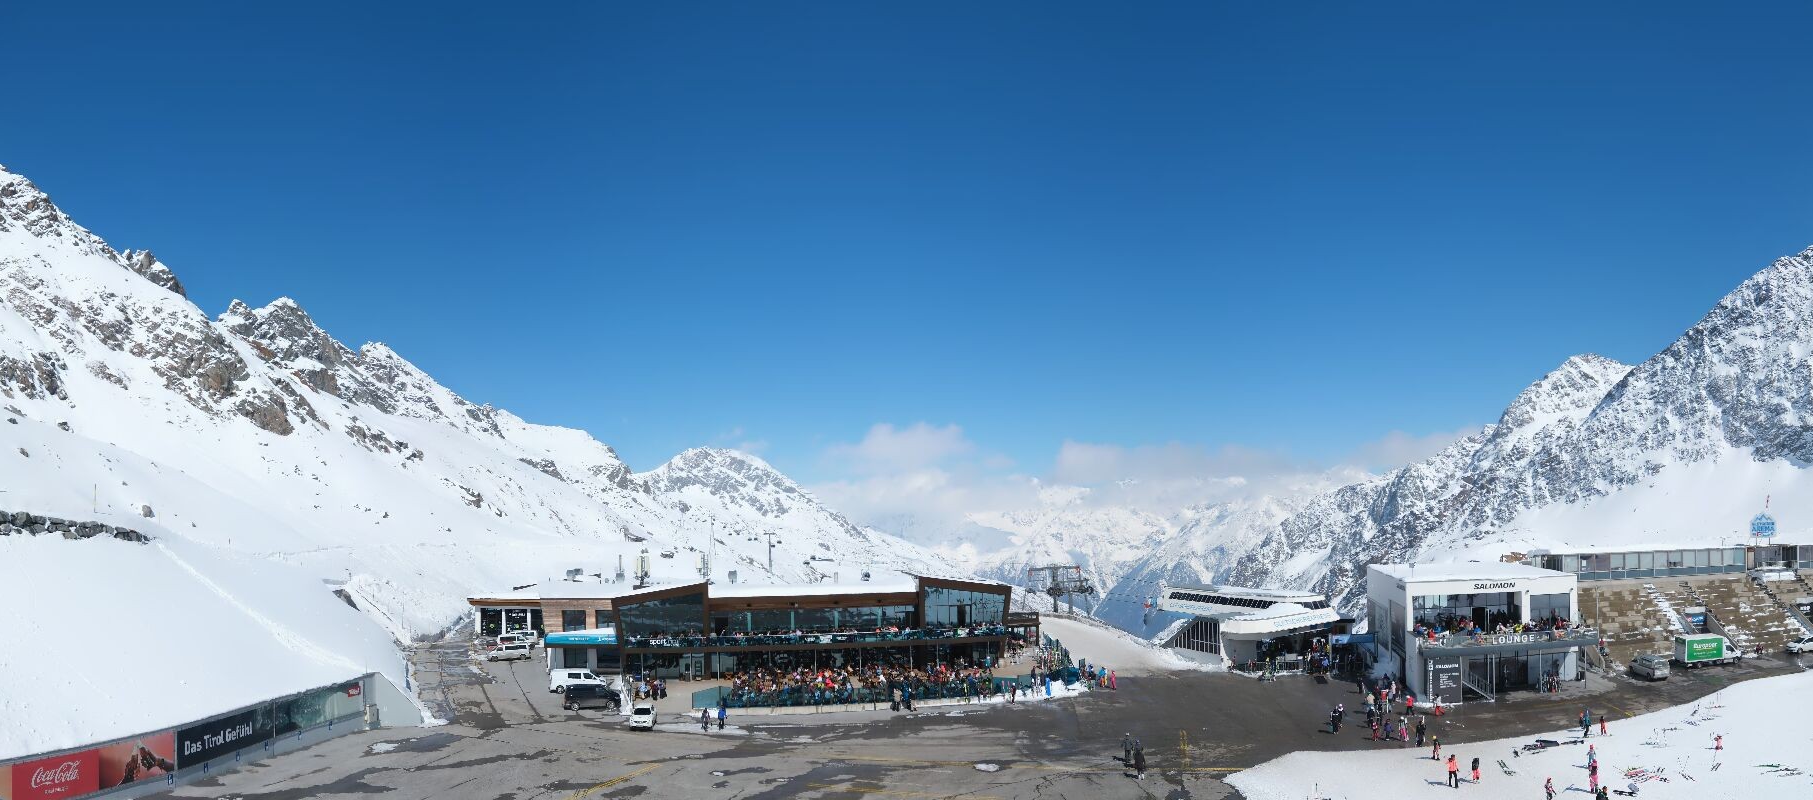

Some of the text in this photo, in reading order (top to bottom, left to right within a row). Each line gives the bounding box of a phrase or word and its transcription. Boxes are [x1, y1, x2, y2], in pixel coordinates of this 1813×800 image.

[1473, 582, 1516, 590] SALOMON
[1492, 634, 1535, 645] LOUNGE
[184, 721, 253, 756] Das Tirol Gefühl
[31, 760, 81, 788] Coca-Cola
